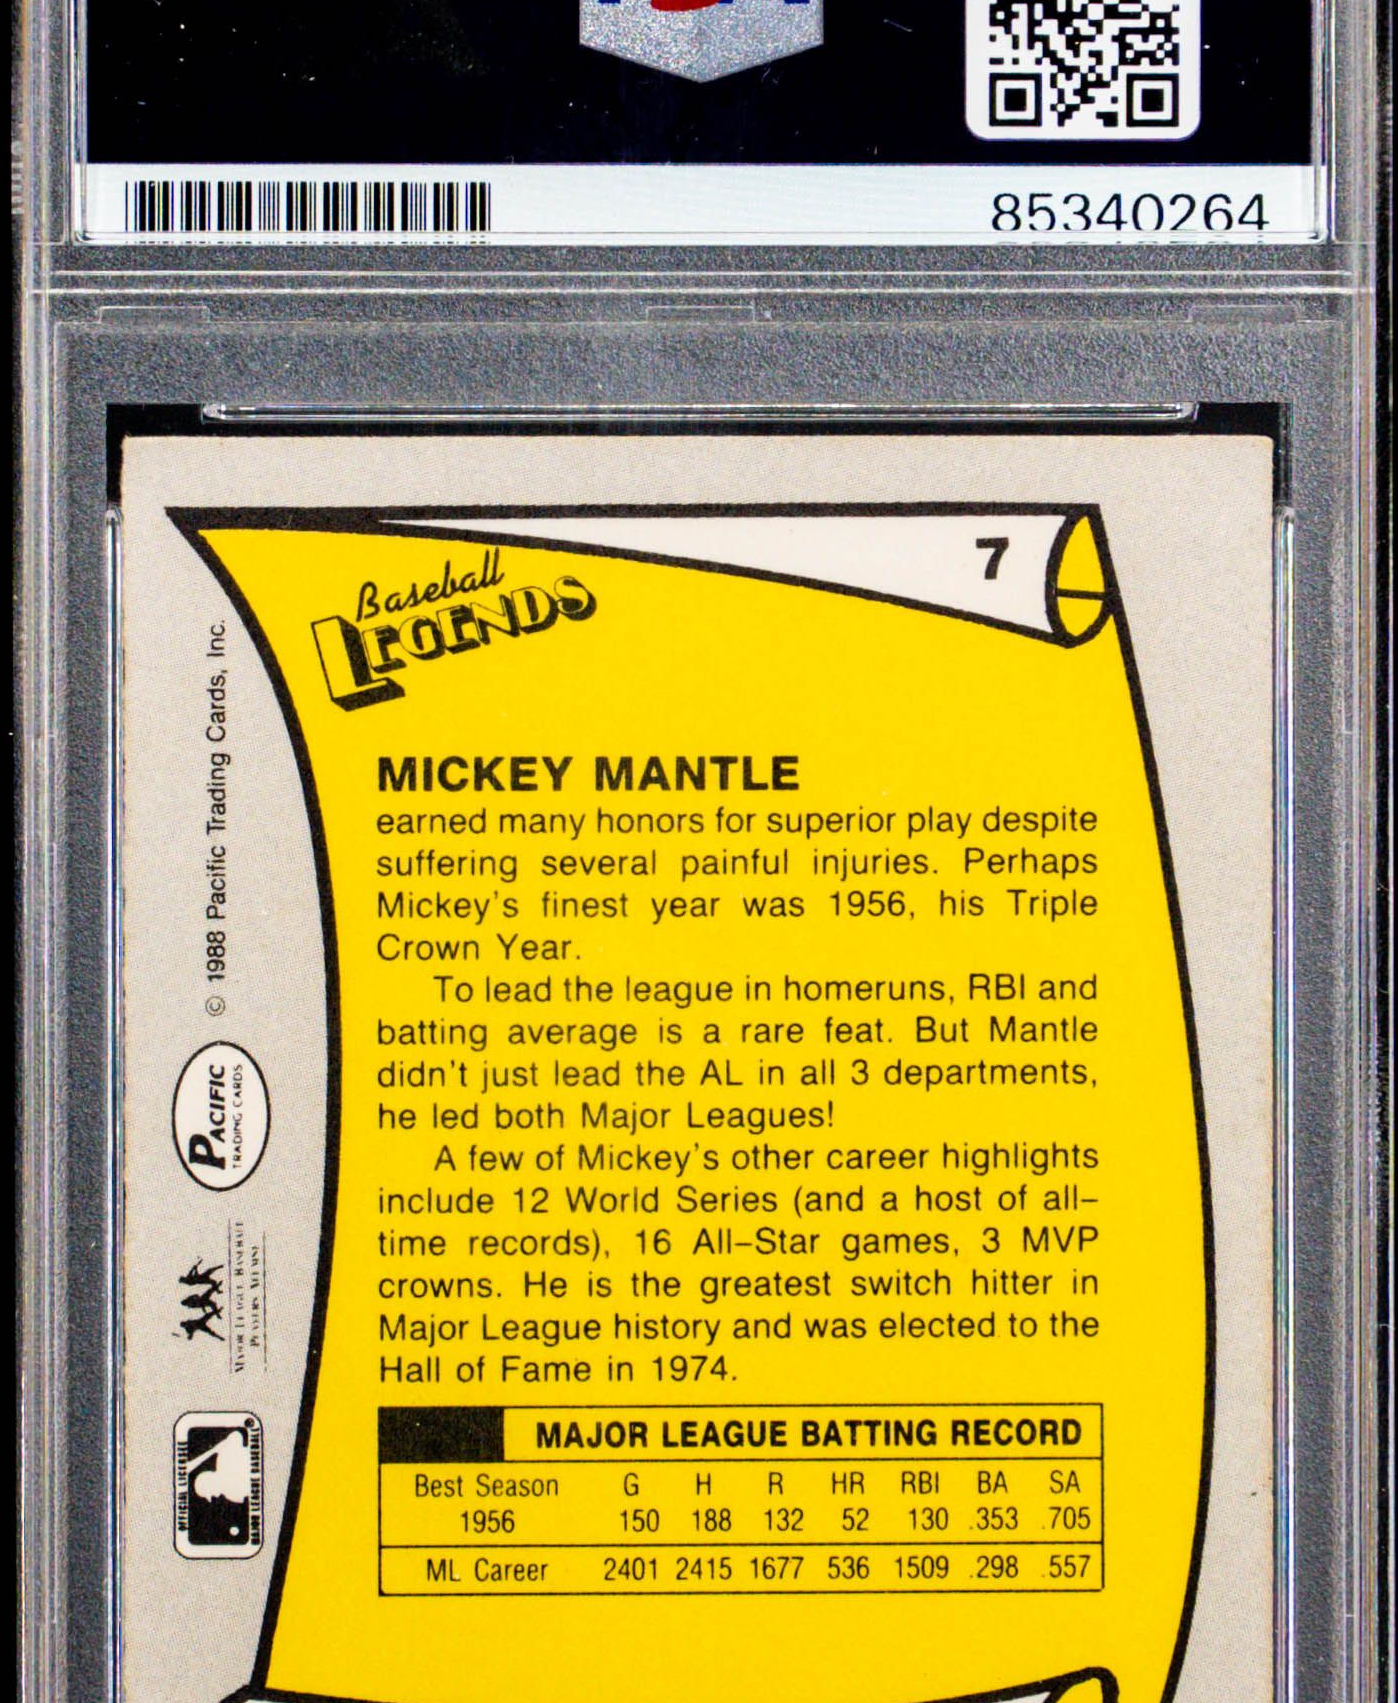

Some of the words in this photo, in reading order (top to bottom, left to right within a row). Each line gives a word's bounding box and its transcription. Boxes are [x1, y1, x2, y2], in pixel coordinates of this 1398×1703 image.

[991, 192, 1270, 231] 85340264
[975, 537, 1010, 580] 7
[355, 547, 505, 622] Baseball
[206, 619, 226, 658] Inc.
[310, 575, 597, 712] LEGENDS
[205, 669, 228, 743] Cards,
[377, 755, 573, 793] MICKEY
[594, 755, 800, 792] MANTLE
[205, 752, 232, 836] Trading
[376, 807, 487, 835] earned
[499, 813, 586, 840] many
[596, 807, 705, 834] honors
[715, 805, 756, 834] for
[767, 805, 897, 840] superior
[907, 805, 972, 840] play
[982, 805, 1098, 839] despite
[205, 845, 227, 920] Pacific
[376, 848, 518, 883] suffering
[541, 849, 656, 877] several
[681, 848, 788, 883] painful
[813, 848, 938, 882] injuries.
[964, 846, 1098, 881] Perhaps
[377, 890, 519, 925] Mickey's
[541, 890, 628, 919] finest
[650, 896, 721, 925] year
[742, 896, 805, 918] was
[829, 890, 915, 920] 1956,
[939, 889, 985, 917] his
[1006, 888, 1098, 923] Triple
[205, 930, 227, 983] 1988
[376, 932, 480, 962] Crown
[496, 933, 581, 961] Year.
[432, 975, 474, 1003] To
[485, 976, 552, 1003] lead
[563, 975, 614, 1003] the
[625, 976, 734, 1006] league
[745, 974, 771, 1002] in
[784, 974, 955, 1004] homeruns,
[968, 972, 1026, 1001] RBI
[1038, 973, 1098, 1001] and
[377, 1018, 488, 1050] batting
[507, 1023, 637, 1050] average
[659, 1017, 683, 1045] is
[703, 1023, 721, 1044] a
[741, 1022, 804, 1044] rare
[824, 1016, 893, 1044] feat.
[915, 1016, 969, 1044] But
[989, 1016, 1098, 1043] Mantle
[232, 1063, 244, 1109] CARDS
[377, 1059, 468, 1089] didn't
[481, 1062, 538, 1094] just
[554, 1059, 620, 1088] lead
[635, 1060, 685, 1087] the
[699, 1058, 744, 1087] AL
[759, 1058, 785, 1086] in
[800, 1058, 835, 1087] all
[851, 1058, 869, 1086] 3
[883, 1058, 1097, 1093] departments,
[188, 1063, 227, 1171] PACIFIC
[378, 1102, 417, 1130] he
[432, 1102, 479, 1130] led
[494, 1102, 564, 1130] both
[581, 1101, 671, 1133] Major
[687, 1100, 834, 1133] Leagues!
[232, 1112, 244, 1169] TRADING
[434, 1144, 457, 1172] A
[468, 1144, 524, 1172] few
[535, 1143, 565, 1172] of
[578, 1142, 720, 1176] Mickey's
[731, 1143, 815, 1171] other
[826, 1148, 930, 1170] career
[942, 1142, 1099, 1176] highlights
[378, 1186, 495, 1215] include
[513, 1186, 549, 1214] 12
[565, 1186, 659, 1214] World
[676, 1184, 778, 1214] Series
[793, 1184, 864, 1217] (and
[880, 1191, 899, 1213] a
[915, 1184, 982, 1212] host
[997, 1184, 1028, 1212] of
[377, 1229, 447, 1257] time
[468, 1228, 610, 1261] records),
[635, 1228, 672, 1256] 16
[841, 1232, 959, 1261] games,
[982, 1226, 1001, 1254] 3
[1022, 1225, 1100, 1253] MVP
[378, 1277, 502, 1300] crowns.
[523, 1270, 568, 1299] He
[587, 1271, 612, 1298] is
[630, 1270, 681, 1298] the
[699, 1270, 832, 1301] greatest
[850, 1268, 952, 1297] switch
[971, 1268, 1053, 1296] hitter
[1072, 1268, 1098, 1295] in
[379, 1313, 470, 1346] Major
[482, 1313, 602, 1346] League
[614, 1312, 721, 1346] history
[732, 1312, 792, 1340] and
[803, 1317, 868, 1340] was
[879, 1311, 996, 1339] elected
[1007, 1312, 1038, 1338] to
[1049, 1310, 1100, 1338] the
[379, 1355, 441, 1384] Hall
[456, 1355, 486, 1384] of
[501, 1355, 592, 1384] Fame
[607, 1355, 634, 1382] in
[652, 1354, 737, 1383] 1974.
[536, 1420, 649, 1450] MAJOR
[661, 1419, 788, 1449] LEAGUE
[801, 1418, 938, 1448] BATTING
[950, 1418, 1082, 1447] RECORD
[414, 1473, 464, 1498] Best
[475, 1472, 559, 1498] Season
[623, 1472, 640, 1497] G
[695, 1472, 712, 1496] H
[768, 1471, 784, 1495] R
[831, 1471, 865, 1495] HR
[901, 1470, 940, 1495] RBI
[977, 1470, 1008, 1495] BA
[1049, 1469, 1081, 1495] SA
[460, 1509, 516, 1534] 1956
[620, 1508, 660, 1533] 150
[692, 1507, 732, 1533] 188
[764, 1507, 804, 1532] 132
[842, 1507, 870, 1532] 52
[908, 1506, 949, 1532] 130
[968, 1506, 1019, 1531] .353
[1041, 1505, 1091, 1530] .705
[426, 1558, 461, 1583] ML
[474, 1557, 548, 1583] Career
[603, 1556, 657, 1582] 2401
[675, 1556, 733, 1581] 2415
[750, 1555, 805, 1581] 1677
[827, 1555, 870, 1580] 536
[894, 1554, 950, 1580] 1509
[968, 1554, 1019, 1580] .298
[1041, 1554, 1091, 1579] .557
